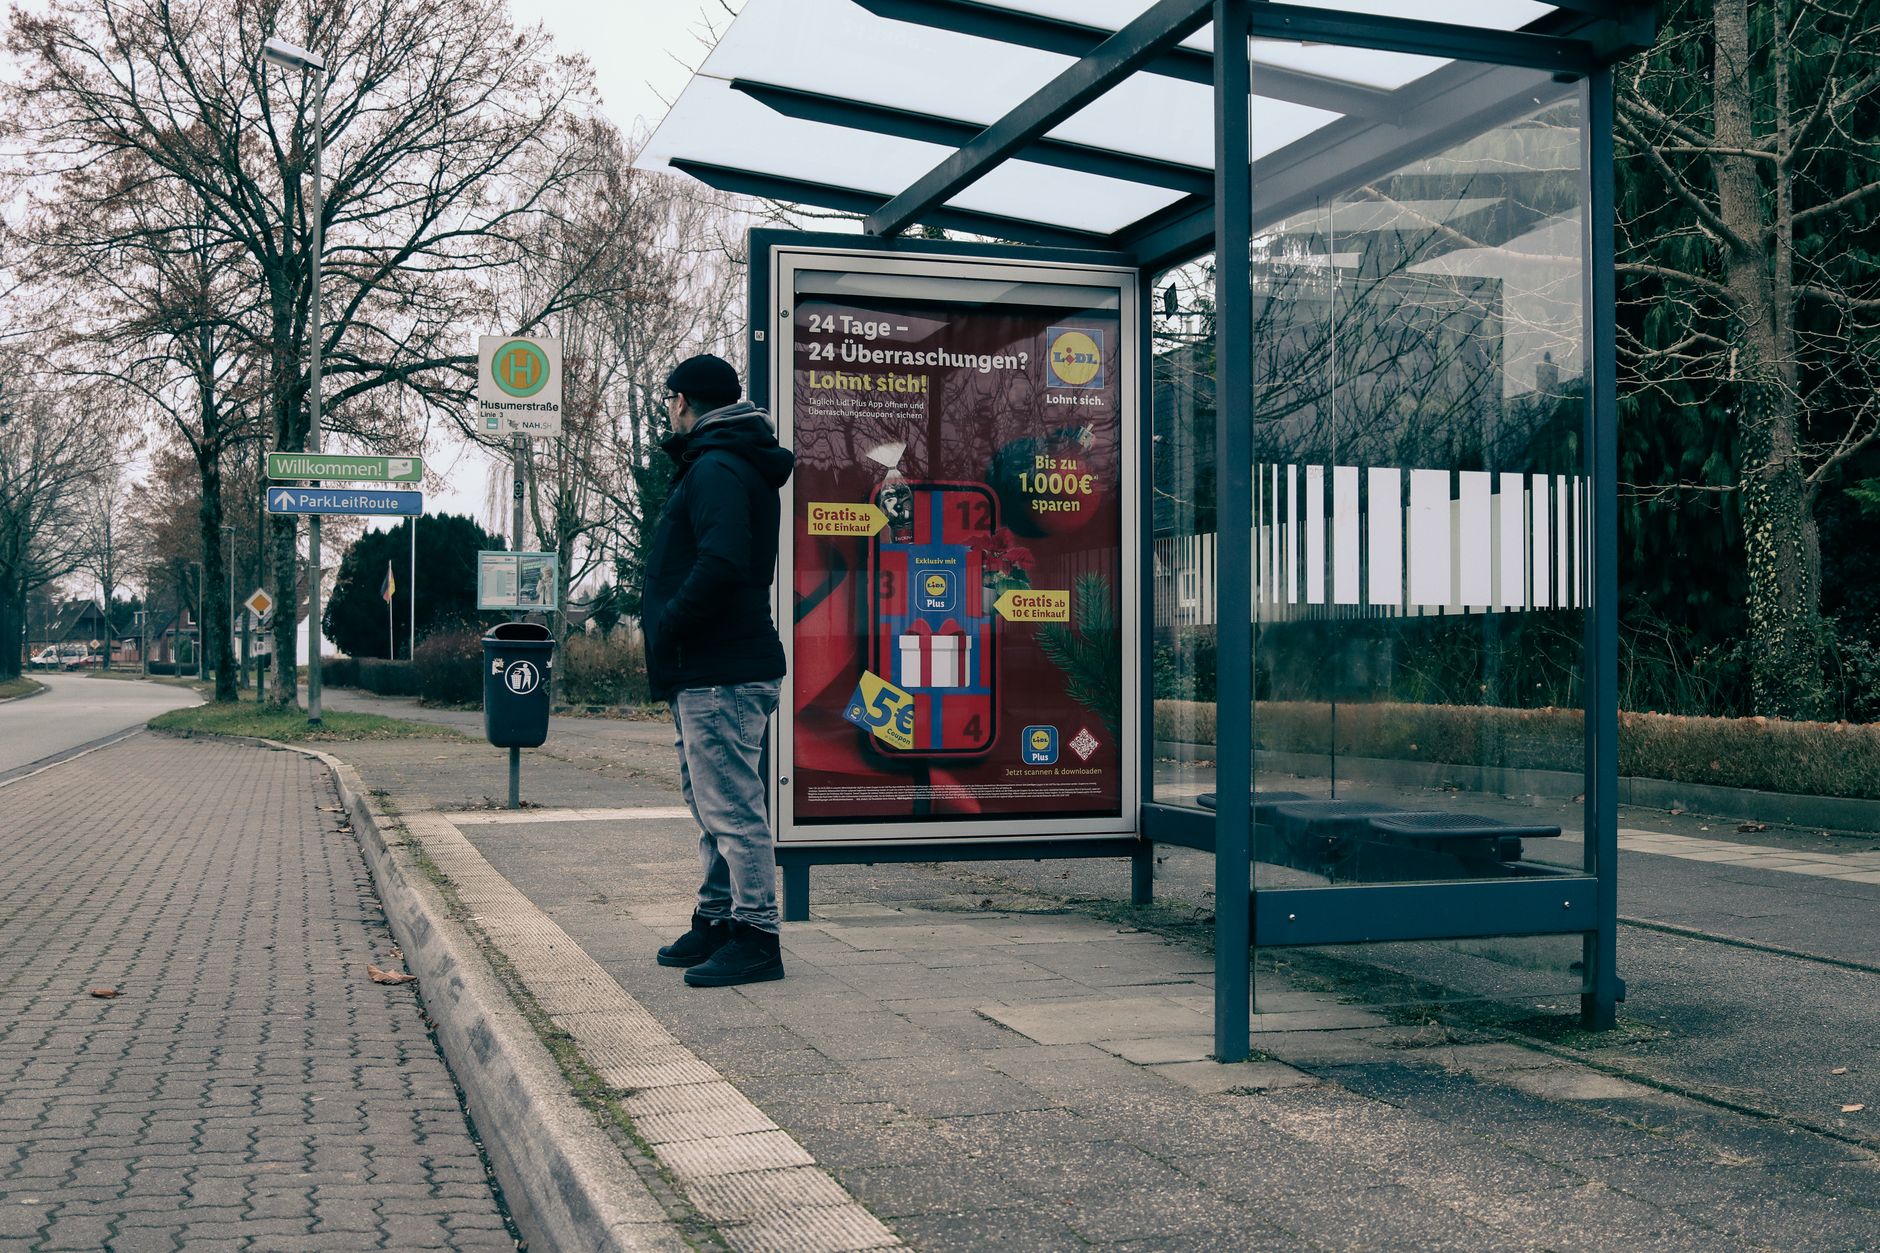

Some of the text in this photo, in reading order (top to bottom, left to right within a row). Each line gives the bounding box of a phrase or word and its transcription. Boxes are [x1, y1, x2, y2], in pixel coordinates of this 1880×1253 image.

[809, 314, 835, 333] 24
[839, 316, 891, 340] Tage
[809, 338, 1028, 373] 24 Überraschungen?
[510, 353, 533, 384] H
[809, 370, 928, 393] Lohnt sich!
[480, 400, 559, 412] Husumerstraße
[809, 398, 835, 407] Täglich
[836, 399, 850, 407] Lidl
[868, 401, 883, 410] App
[885, 400, 908, 409] öffnen
[1046, 394, 1105, 406] Lohnt sich.
[896, 411, 923, 419] sichern
[276, 459, 382, 476] Willkommen!
[1035, 455, 1077, 470] Bis zu
[300, 495, 398, 509] ParkLeitRoute
[1032, 499, 1080, 513] sparen
[812, 507, 870, 521] Gratis ab
[956, 501, 990, 530] 12
[813, 523, 871, 532] 10 € Einkauf
[915, 557, 956, 565] Exklusiv mit
[926, 599, 945, 608] Plus
[1011, 594, 1065, 608] Gratis ab
[1012, 609, 1066, 618] 10 € Einkauf
[864, 686, 914, 735] 5€
[962, 713, 983, 742] 4
[887, 728, 911, 745] Coupon
[1032, 753, 1049, 761] Plus
[1005, 768, 1022, 776] Jetzt
[1024, 768, 1053, 776] scannen
[1061, 767, 1102, 775] downloaden
